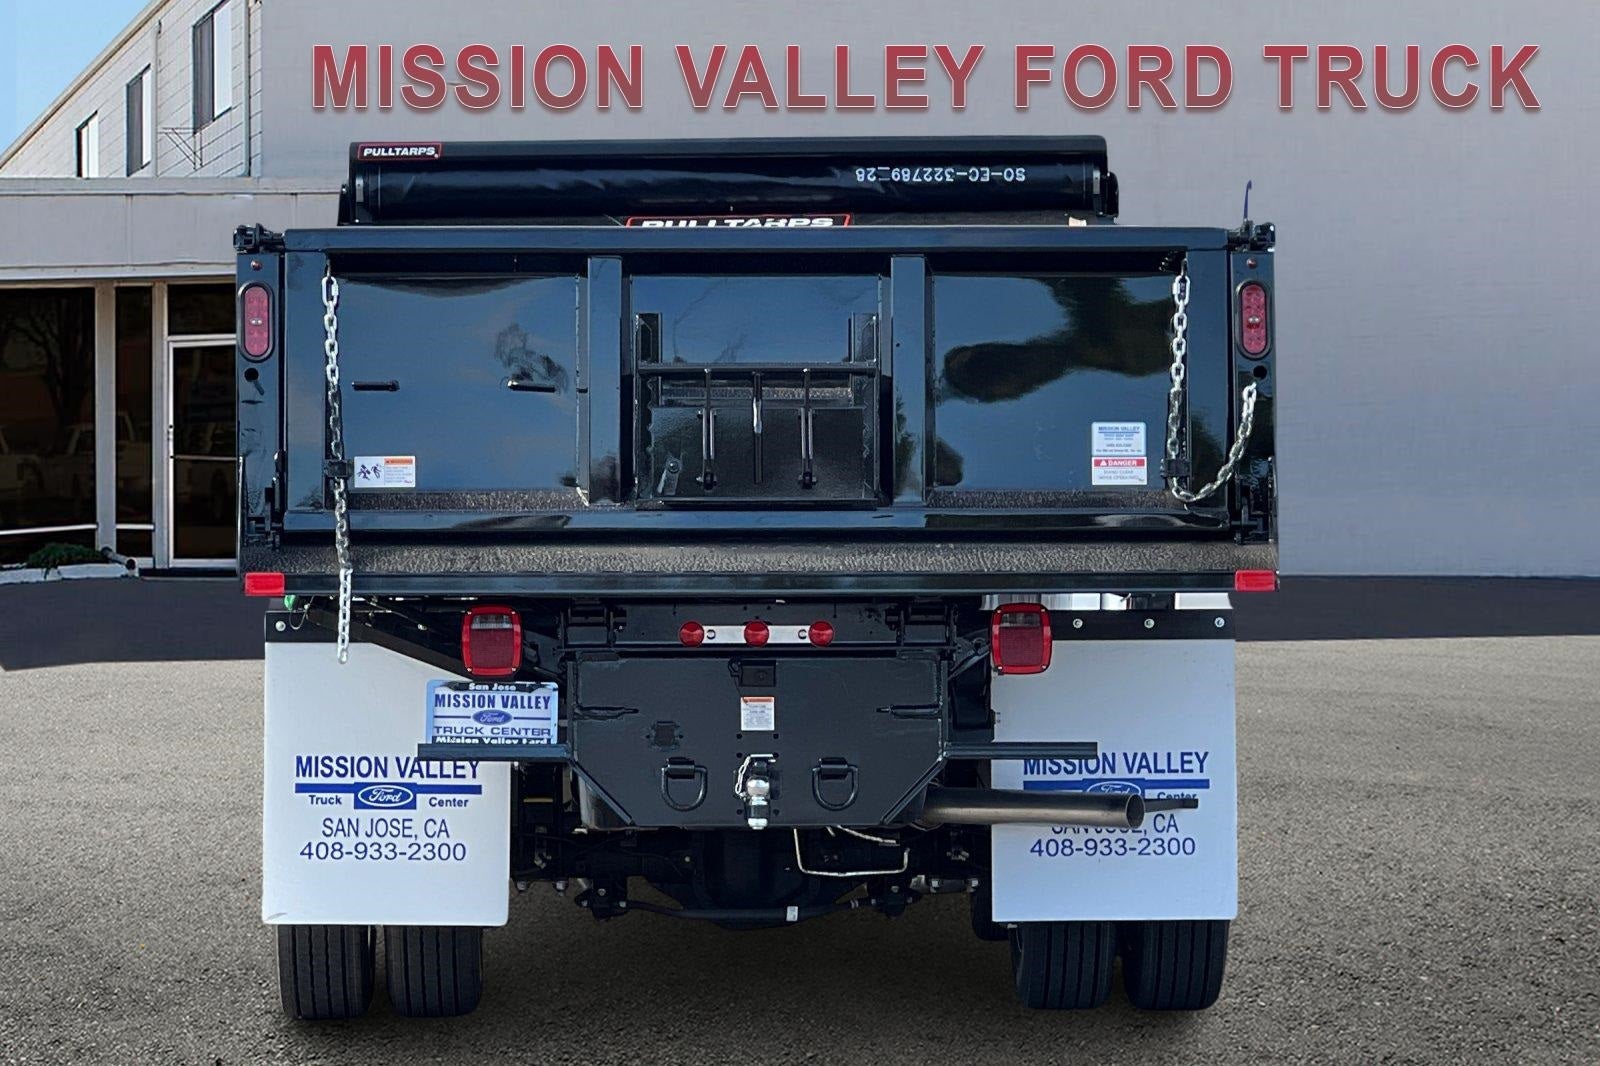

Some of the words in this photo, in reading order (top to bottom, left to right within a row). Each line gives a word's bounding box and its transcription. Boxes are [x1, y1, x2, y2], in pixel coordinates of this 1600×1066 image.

[363, 147, 436, 157] PULLTARPS
[468, 682, 489, 691] San
[492, 682, 516, 691] Jose
[434, 694, 496, 709] MISSION
[501, 694, 551, 710] VALLEY
[480, 712, 505, 724] Ford
[434, 726, 485, 735] TRUCK
[491, 727, 551, 736] CENTER
[295, 755, 388, 779] MISSION
[395, 756, 480, 779] VALLEY
[1023, 751, 1116, 776] MISSION
[1122, 751, 1209, 774] VALLEY
[309, 795, 342, 805] Truck
[368, 788, 403, 803] Ford
[428, 797, 469, 807] Center
[322, 817, 359, 838] SAN
[365, 818, 418, 841] JOSE,
[424, 818, 450, 839] CA
[1153, 813, 1180, 834] CA
[299, 841, 467, 861] 408-933-2300
[1030, 837, 1196, 857] 408-933-2300
